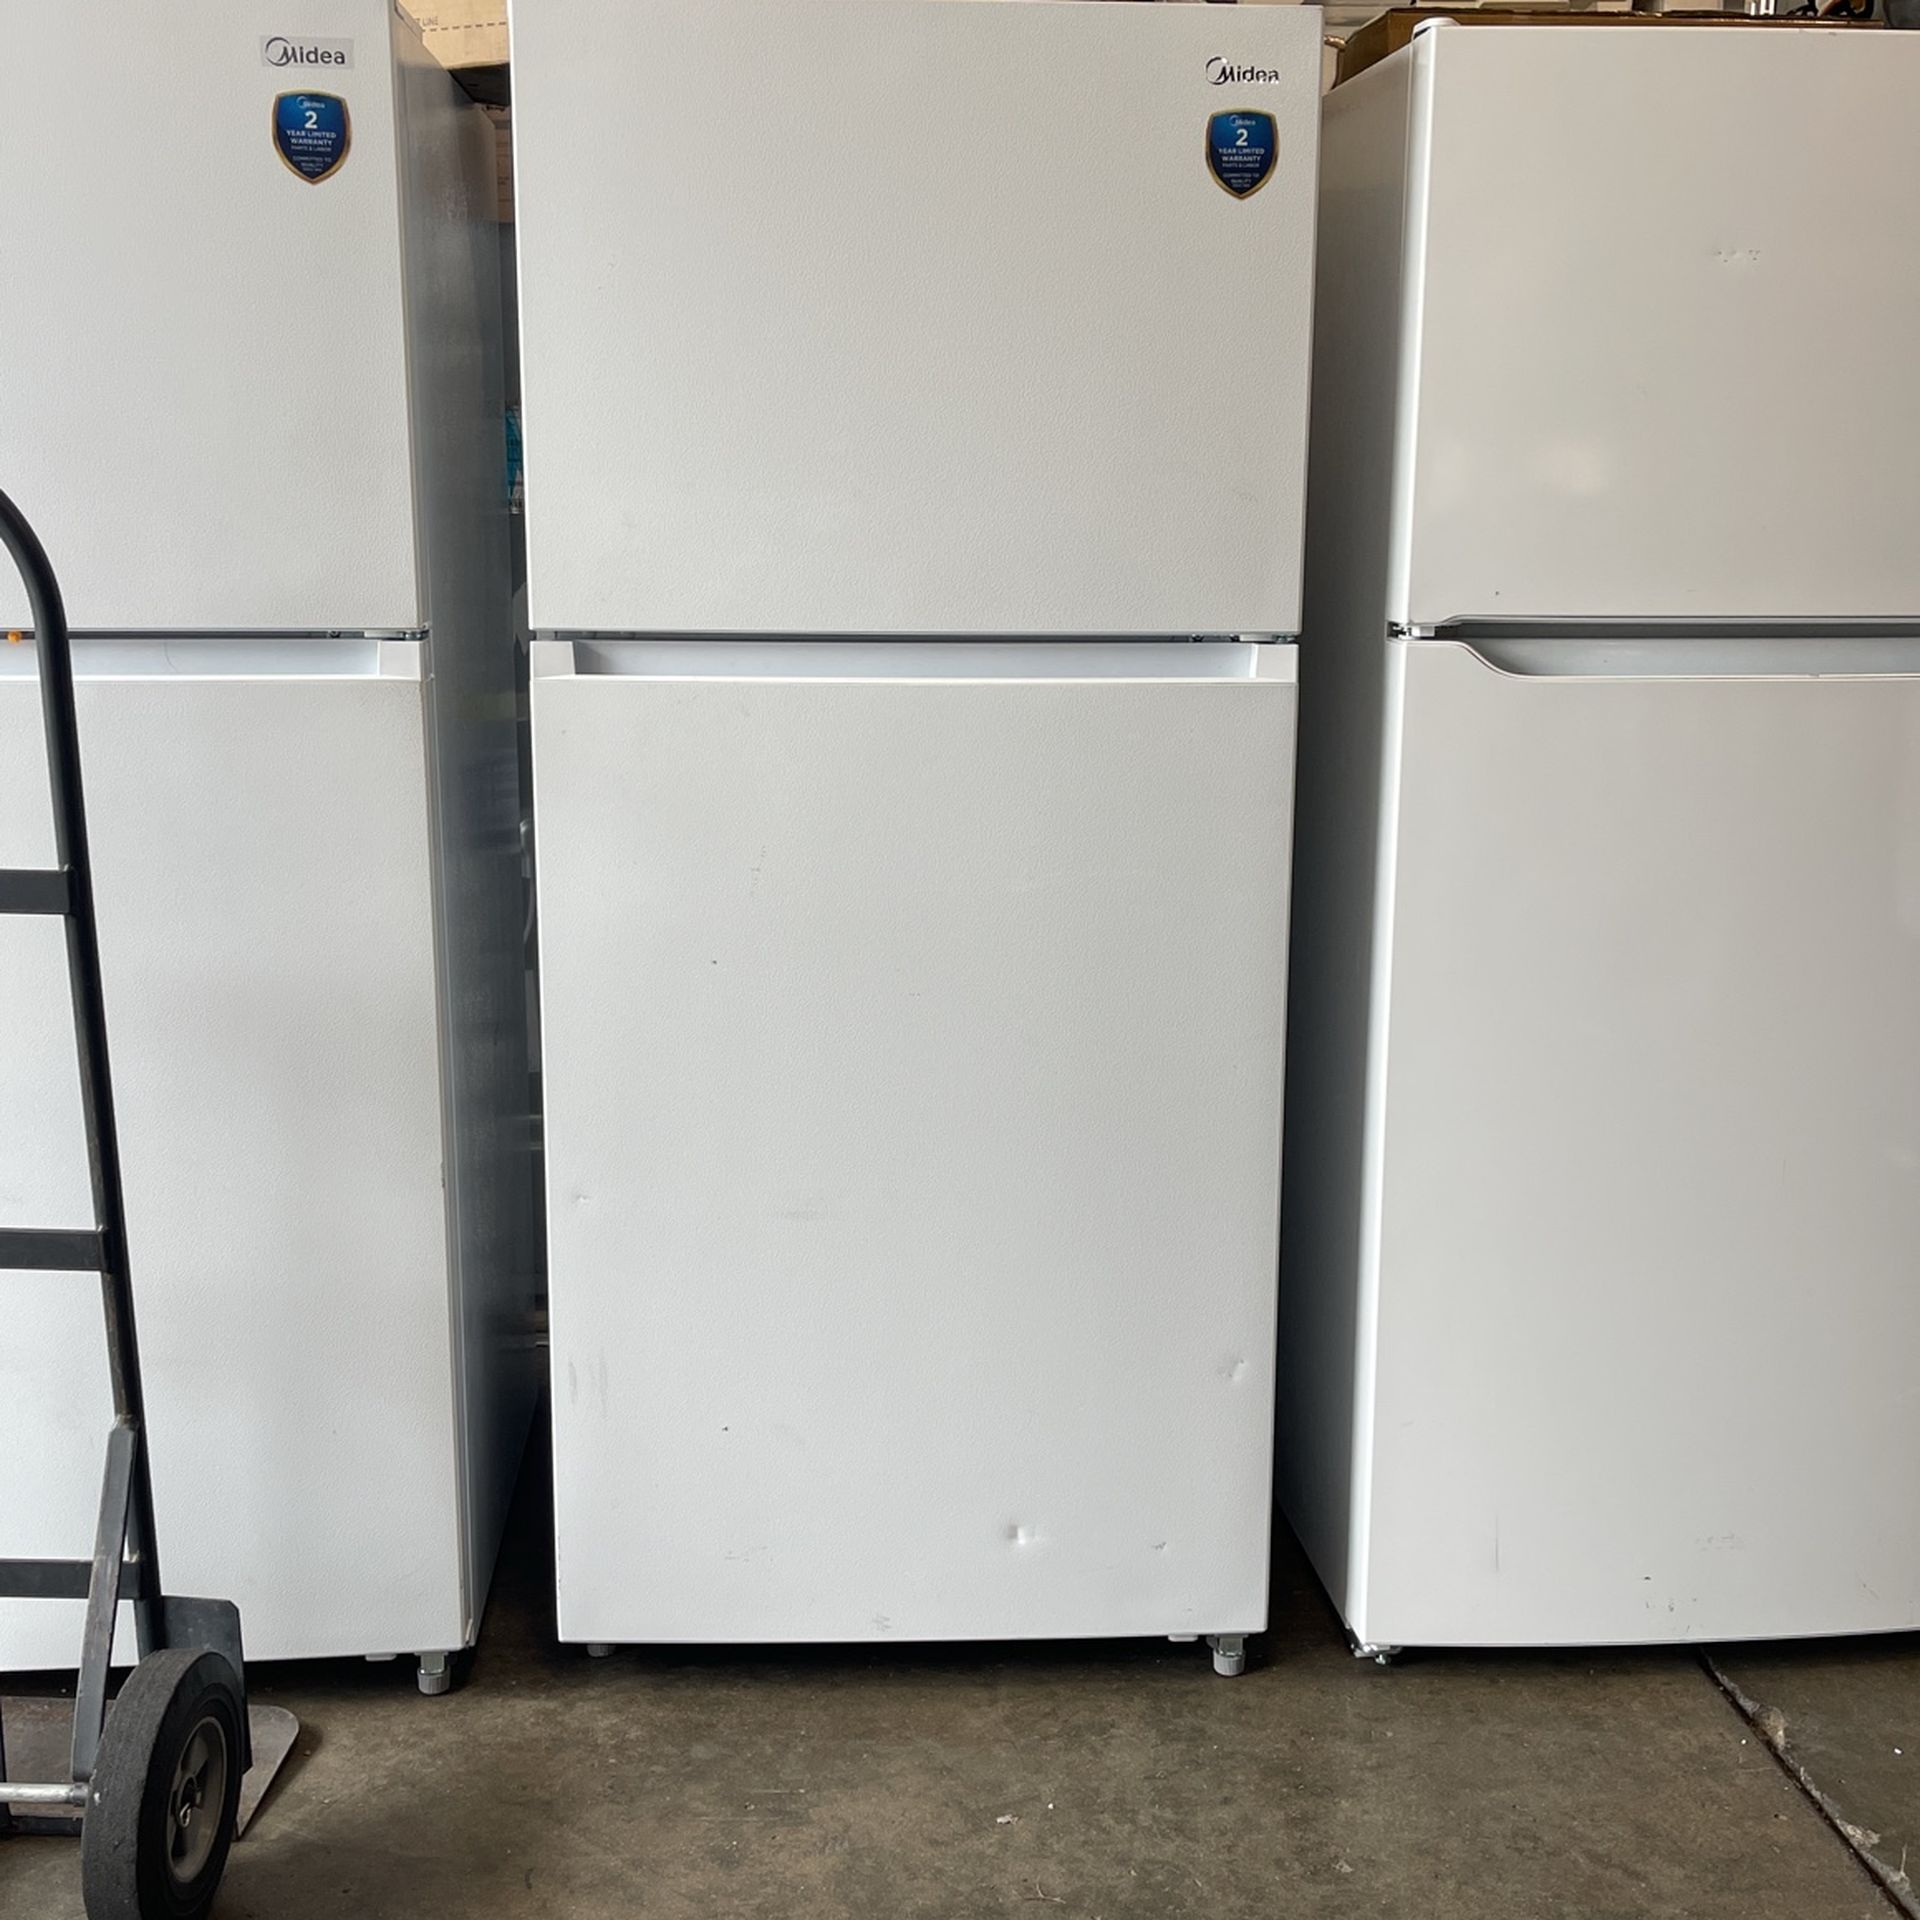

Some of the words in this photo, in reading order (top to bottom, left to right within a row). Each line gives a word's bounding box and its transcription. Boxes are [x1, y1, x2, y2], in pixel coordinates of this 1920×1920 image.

[265, 37, 345, 66] Midea
[1206, 56, 1279, 85] Midea
[296, 95, 326, 109] Midea
[304, 110, 318, 129] 2
[1229, 114, 1256, 127] Midea
[290, 138, 333, 146] WARRANTY
[307, 130, 337, 138] LIMITED
[1235, 128, 1248, 146] 2
